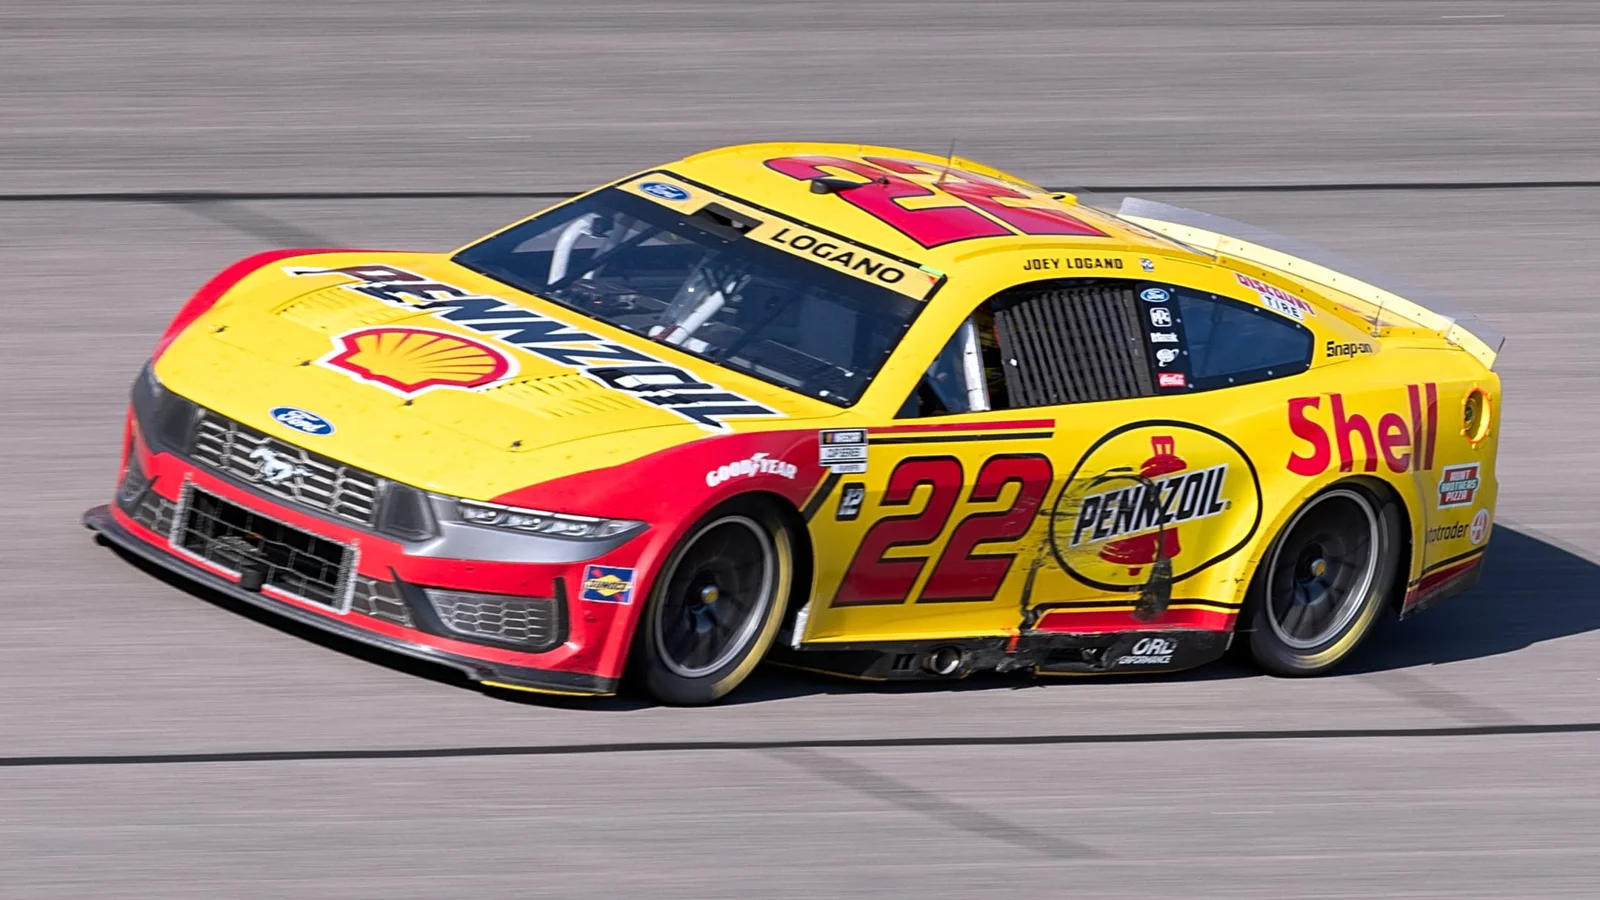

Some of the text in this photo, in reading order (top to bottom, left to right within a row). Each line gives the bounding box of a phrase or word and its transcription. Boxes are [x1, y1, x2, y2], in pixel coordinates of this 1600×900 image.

[644, 184, 685, 199] Ford
[764, 155, 1111, 250] 22
[772, 227, 906, 286] LOGANO
[1023, 257, 1124, 270] JOEY LOGANO
[1234, 272, 1316, 316] DISCOUNT
[1264, 295, 1300, 318] TIRE
[284, 264, 786, 432] PENNZOIL
[1326, 340, 1373, 359] Snap-on
[277, 409, 327, 433] Ford
[1286, 382, 1438, 477] Shell
[705, 452, 798, 487] GOODYEAR
[1069, 463, 1229, 548] PENNZOIL
[829, 453, 1054, 609] 22
